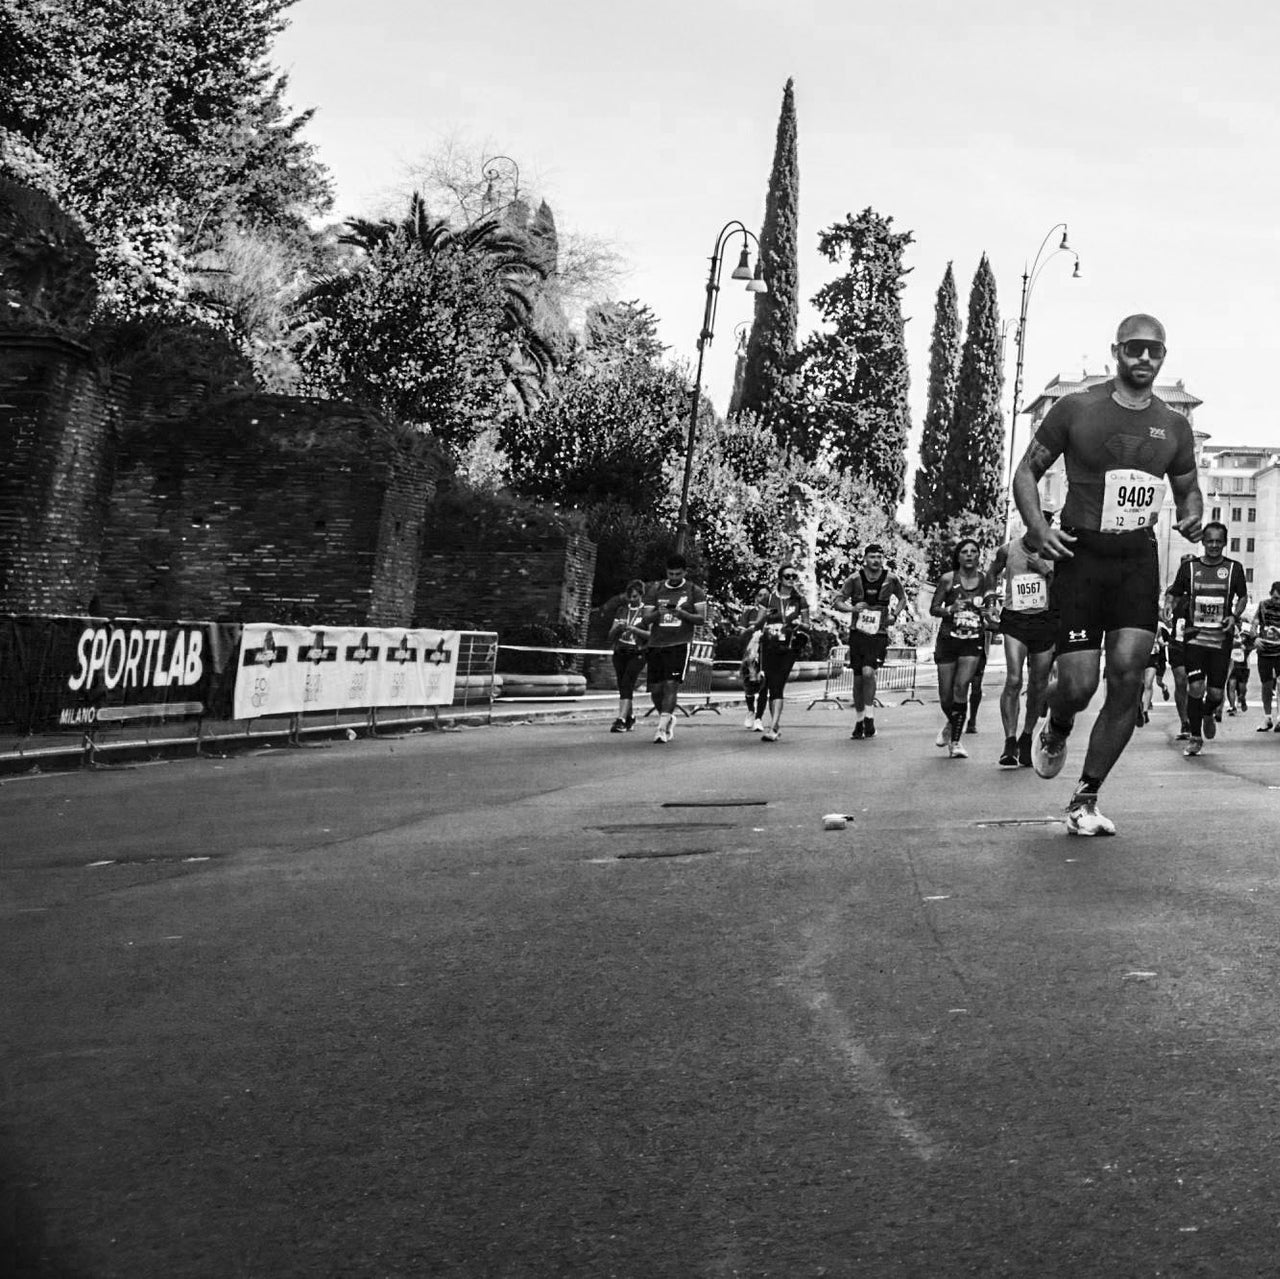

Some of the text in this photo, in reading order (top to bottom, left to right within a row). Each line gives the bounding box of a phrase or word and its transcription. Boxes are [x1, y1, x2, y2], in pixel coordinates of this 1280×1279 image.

[1117, 486, 1155, 507] 9403
[1116, 516, 1145, 526] 12 D
[1017, 582, 1040, 595] 10567
[68, 628, 203, 690] SPORTLAB
[59, 707, 96, 724] MILANO
